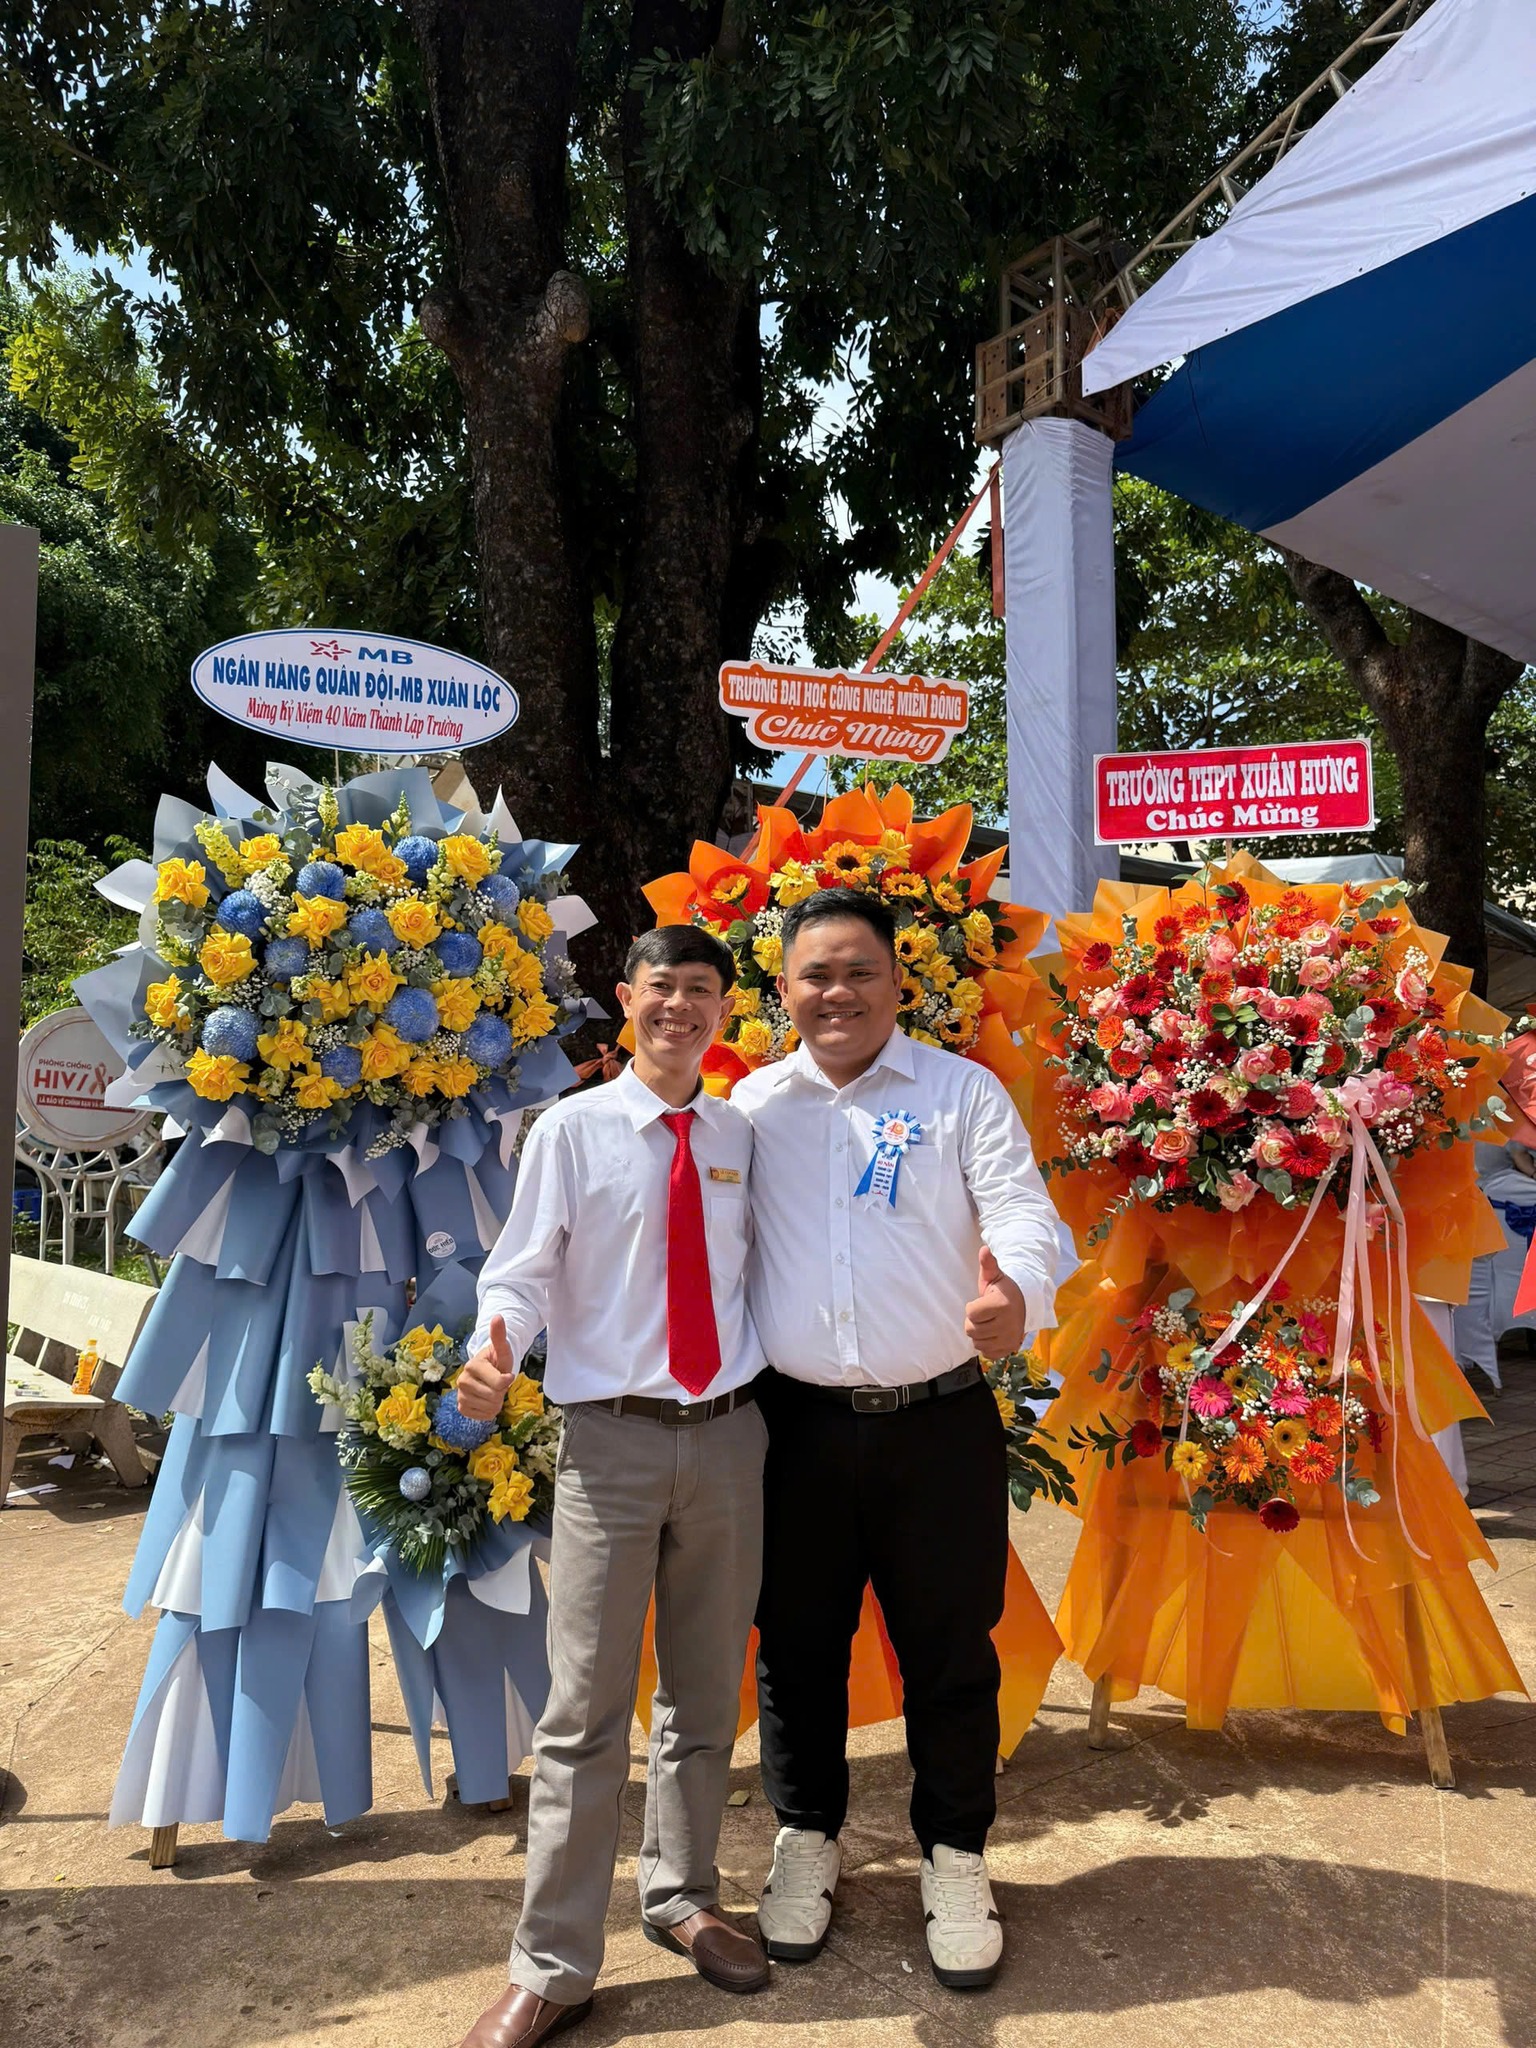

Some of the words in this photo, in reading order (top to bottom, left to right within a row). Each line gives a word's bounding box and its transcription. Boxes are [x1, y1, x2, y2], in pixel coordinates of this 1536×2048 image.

[358, 647, 413, 664] MB
[213, 654, 259, 687] NGÂN
[265, 657, 311, 692] HÀNG
[316, 664, 360, 697] QUÂN
[365, 668, 423, 706] ĐỘI-MB
[427, 676, 469, 708] XUÂN
[473, 680, 500, 717] LỘC
[728, 672, 778, 704] TRƯỜNG
[780, 680, 802, 710] ĐẠI
[804, 682, 827, 712] HỌC
[829, 680, 860, 712] CÔNG
[863, 685, 895, 719] NGHỆ
[897, 682, 928, 718] MIỀN
[930, 690, 961, 721] ĐÔNG
[246, 696, 278, 726] Mừng
[280, 699, 294, 727] Kỷ
[295, 702, 323, 729] Niệm
[325, 705, 341, 725] 40
[342, 706, 366, 728] Năm
[369, 709, 402, 732] Thành
[404, 713, 424, 739] Lập
[427, 715, 463, 743] Trường
[760, 715, 838, 741] Chúc
[845, 721, 939, 756] Mừng
[1106, 760, 1185, 806] TRƯỜNG
[1188, 764, 1236, 802] THPT
[1241, 752, 1296, 799] XUÂN
[1300, 755, 1359, 796] HƯNG
[1146, 807, 1224, 831] Chúc
[1232, 803, 1319, 828] Mừng
